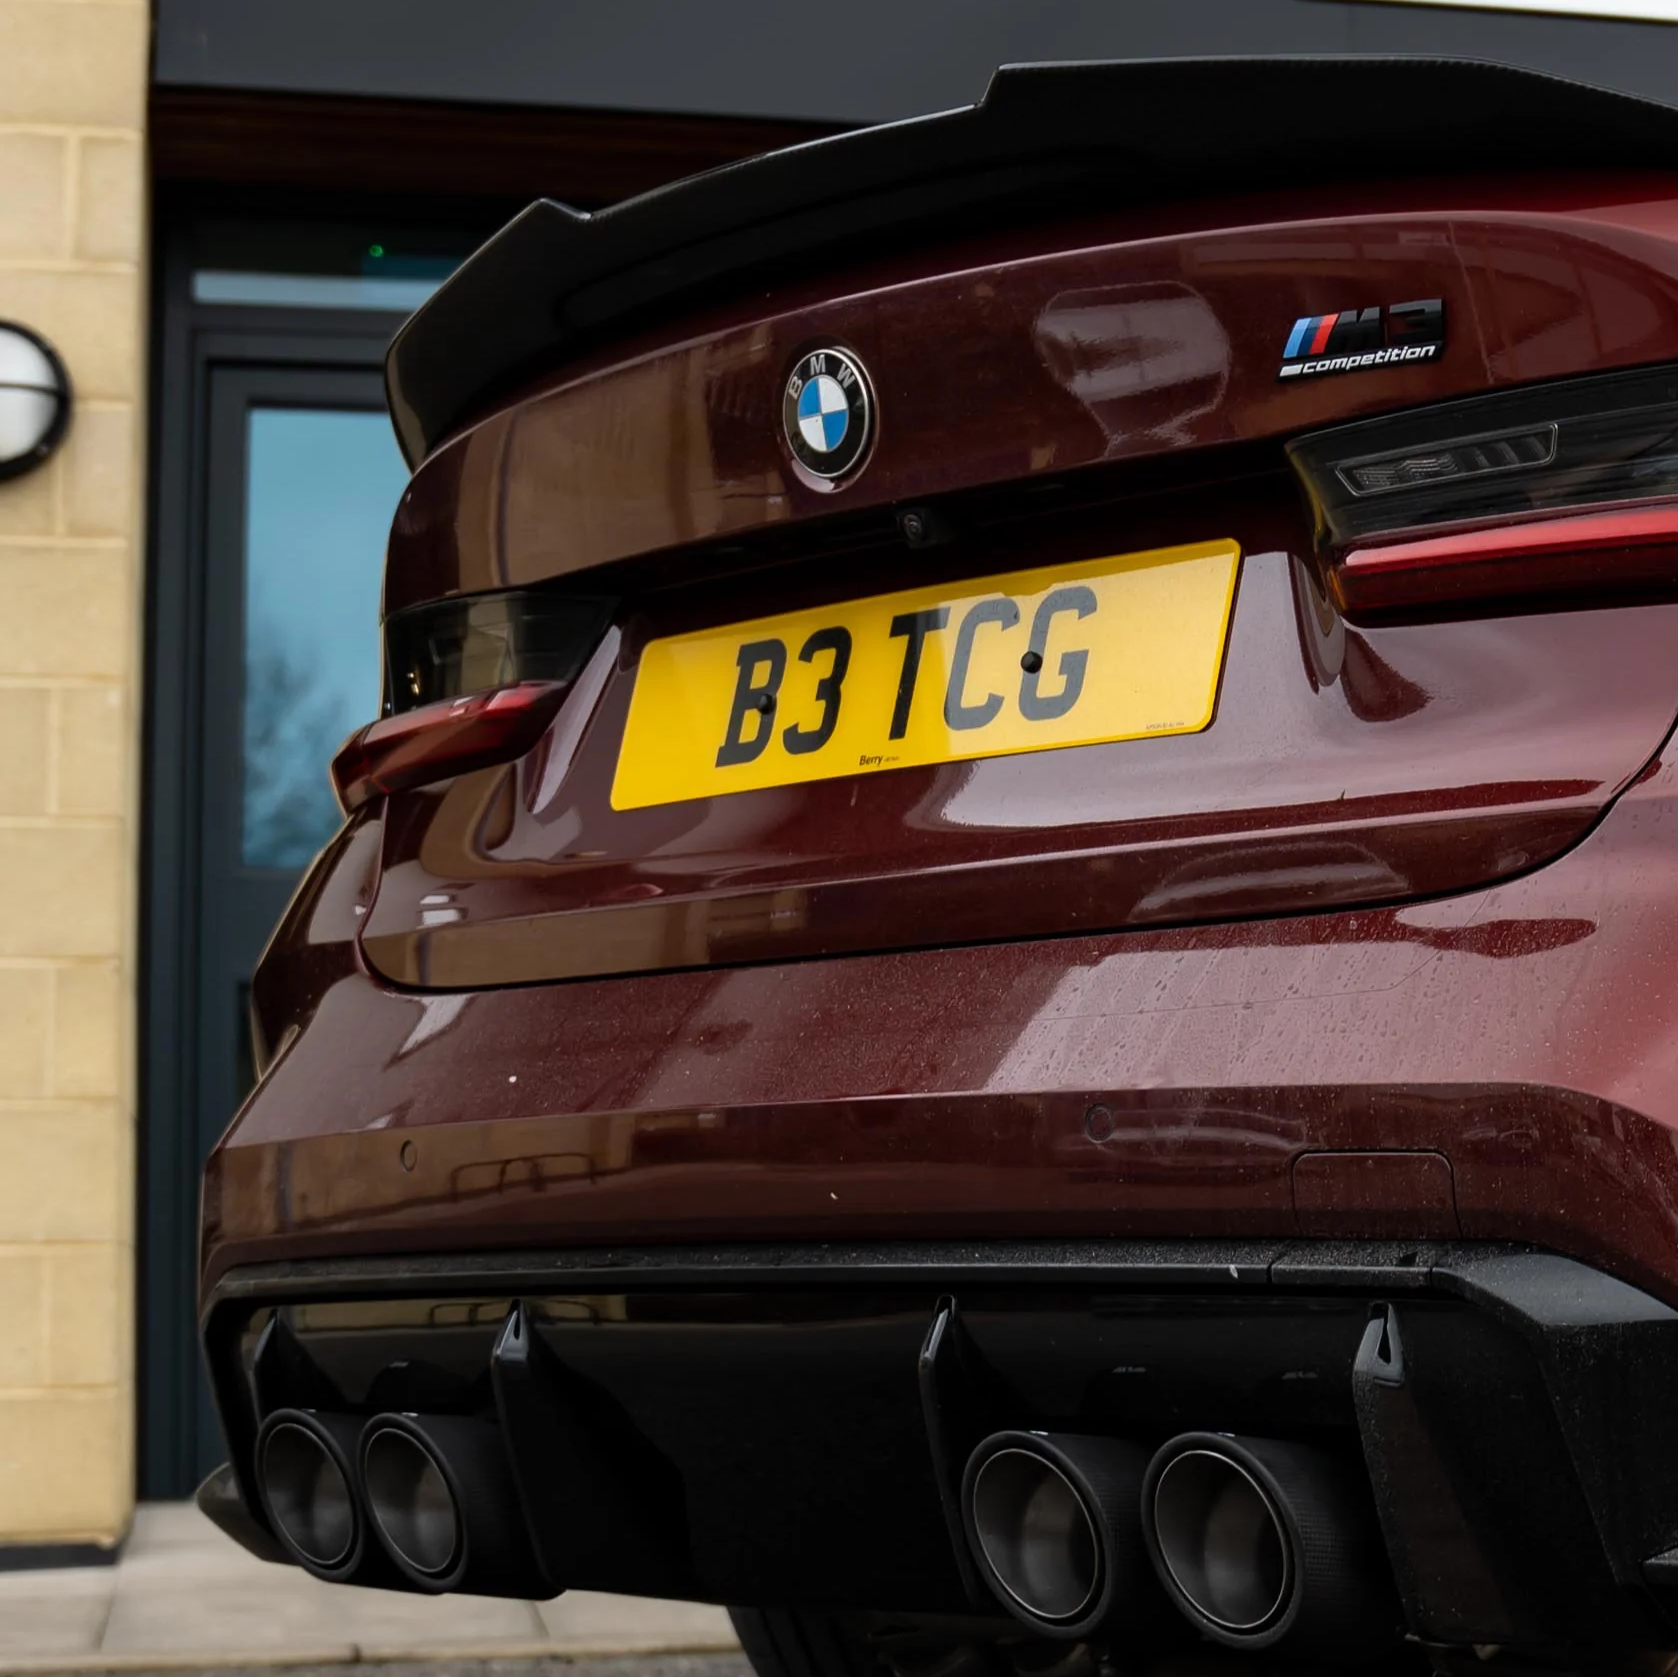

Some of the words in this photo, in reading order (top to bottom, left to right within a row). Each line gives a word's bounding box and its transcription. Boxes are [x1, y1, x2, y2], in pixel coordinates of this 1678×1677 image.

[788, 353, 856, 400] BMW
[1302, 345, 1436, 374] competition
[715, 625, 852, 768] B3
[888, 586, 1097, 741] TCG
